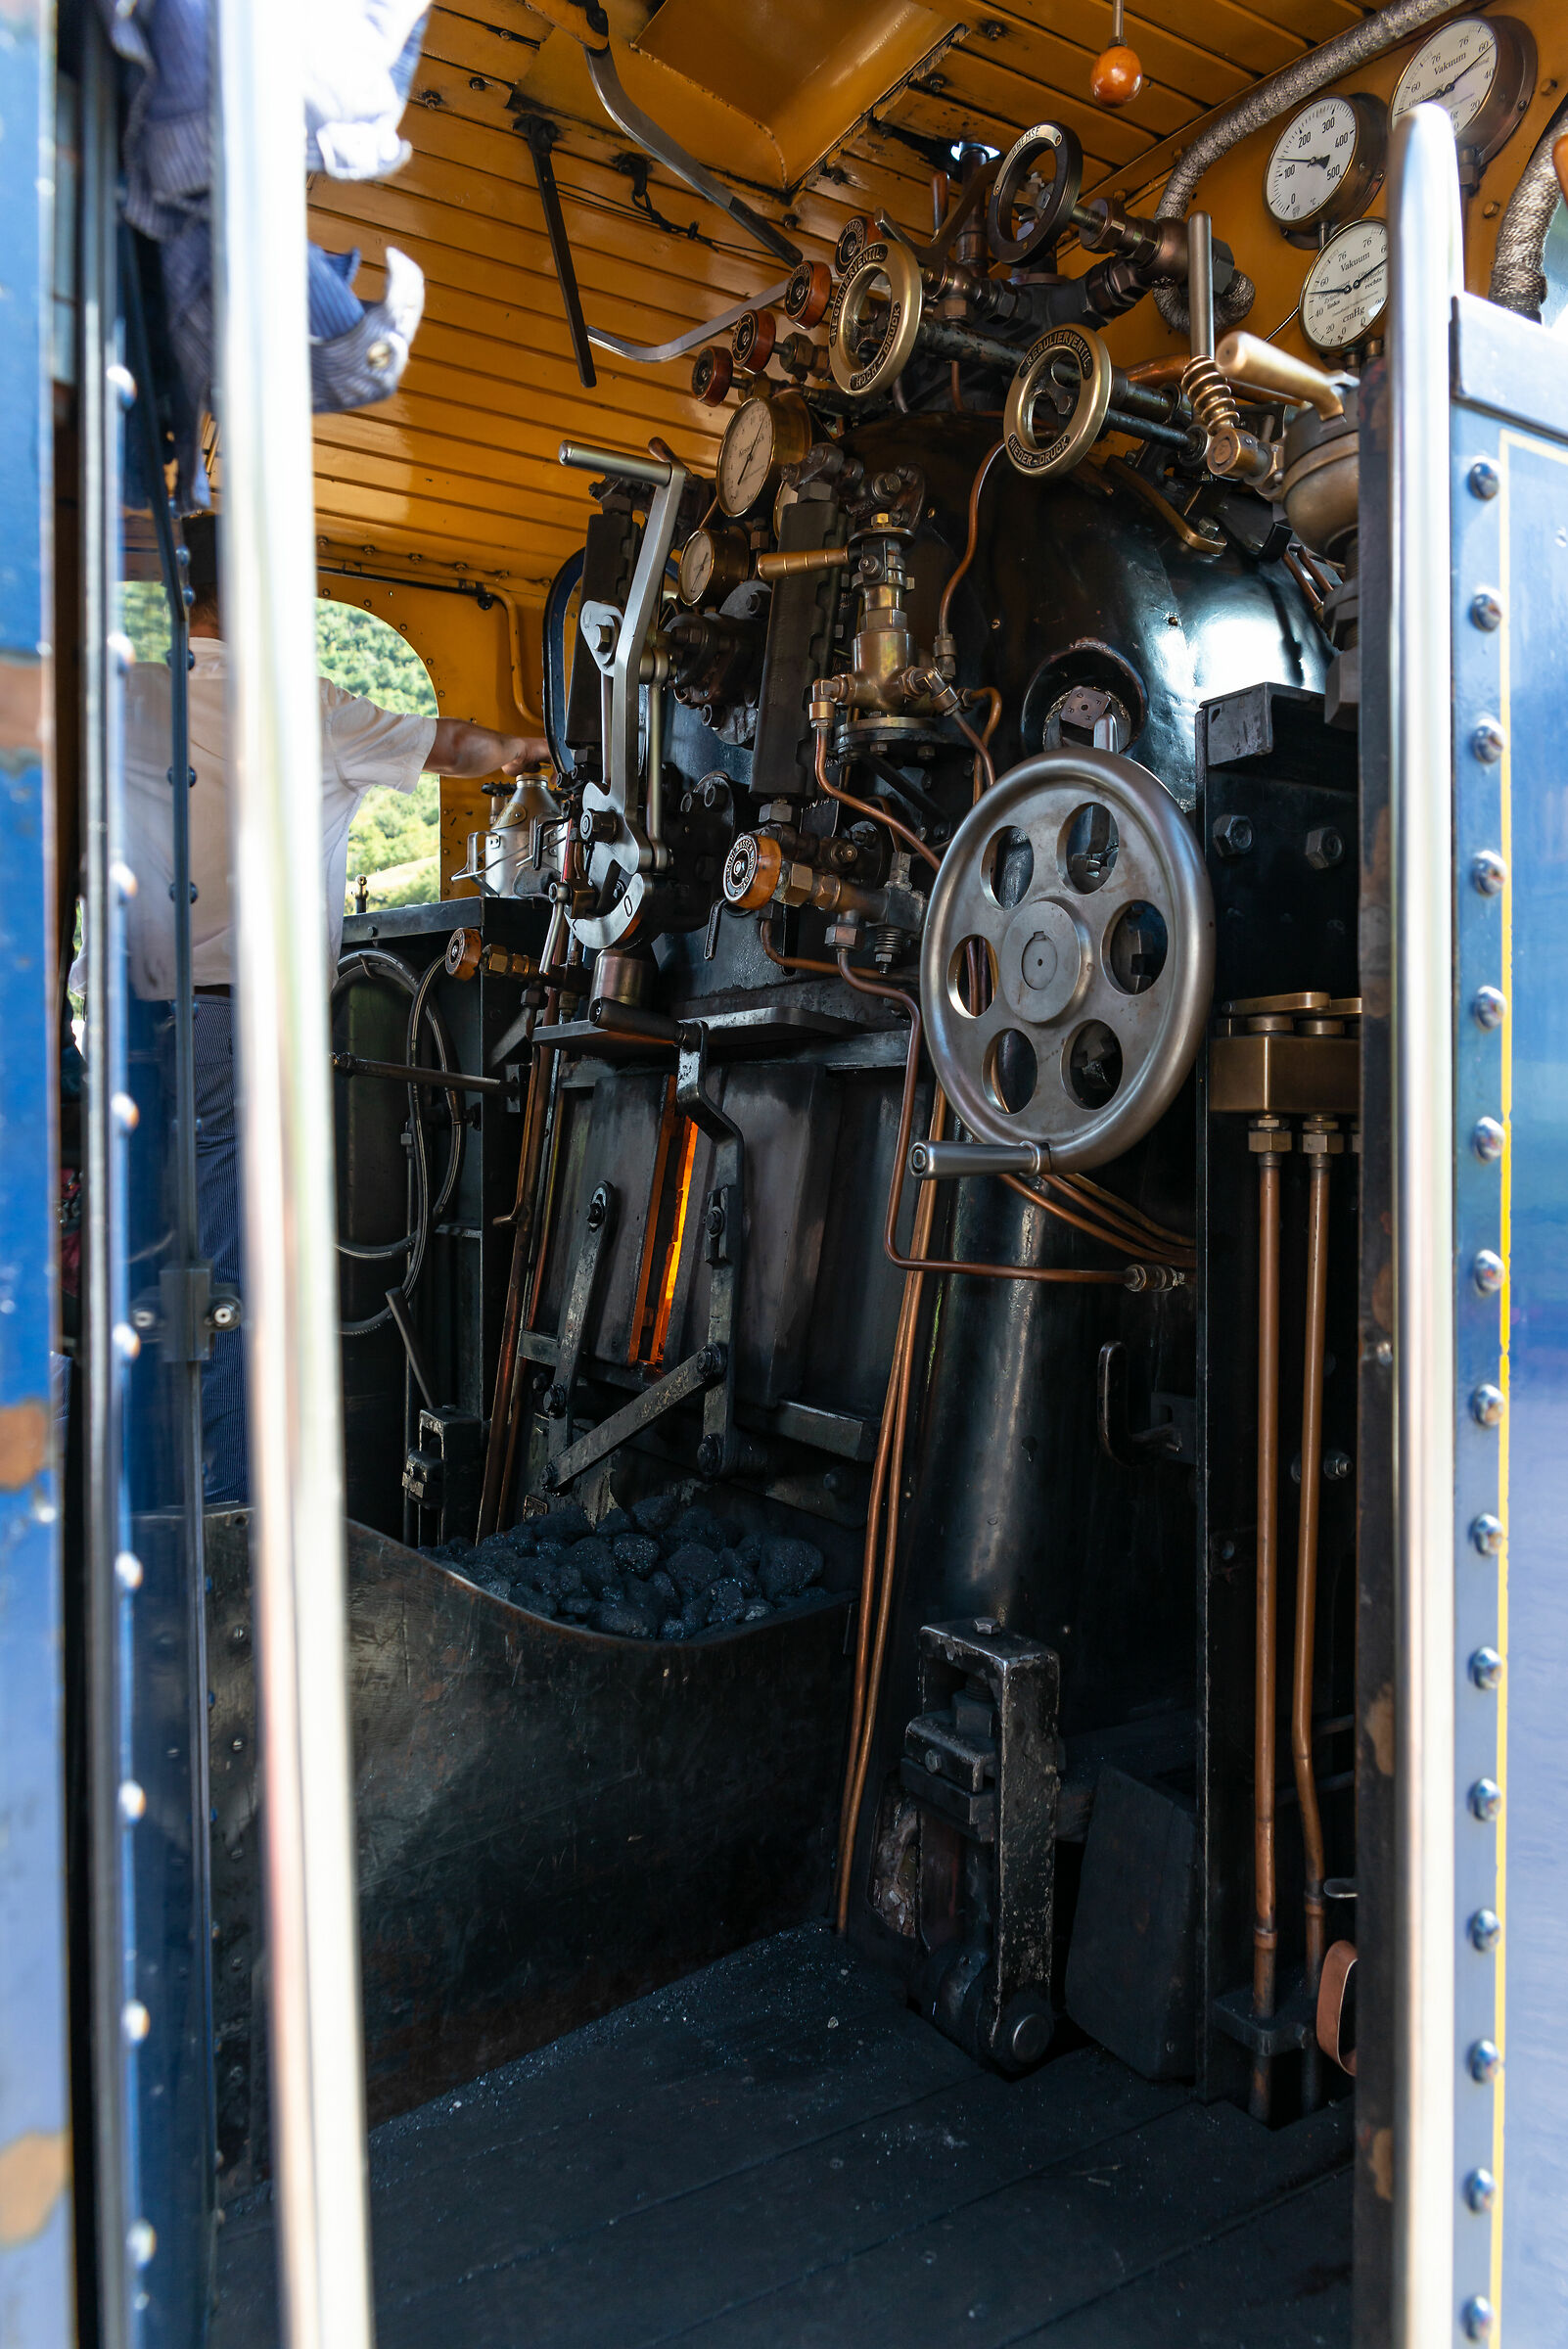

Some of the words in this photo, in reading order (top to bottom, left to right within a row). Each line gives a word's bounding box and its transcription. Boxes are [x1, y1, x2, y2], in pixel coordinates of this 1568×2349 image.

[1458, 36, 1469, 48] 76
[1478, 41, 1489, 53] 60
[1431, 53, 1441, 65] 76
[1434, 53, 1466, 75] Vakuum
[1410, 81, 1420, 93] 60
[1470, 100, 1480, 112] 20
[1321, 116, 1335, 133] 300
[1011, 126, 1041, 156] BREMSE
[1298, 131, 1312, 149] 200
[1335, 132, 1349, 148] 400
[1284, 164, 1296, 179] 100
[1327, 164, 1340, 180] 500
[1291, 193, 1296, 204] 0
[1362, 237, 1372, 249] 76
[1338, 251, 1347, 262] 76
[1340, 252, 1370, 272] Vakuum
[1319, 277, 1329, 287] 60
[1314, 307, 1324, 318] 40
[1342, 305, 1365, 323] cmHg
[1325, 323, 1335, 335] 20
[1341, 326, 1347, 335] 0
[1025, 331, 1091, 368] REGULIERVENTIL
